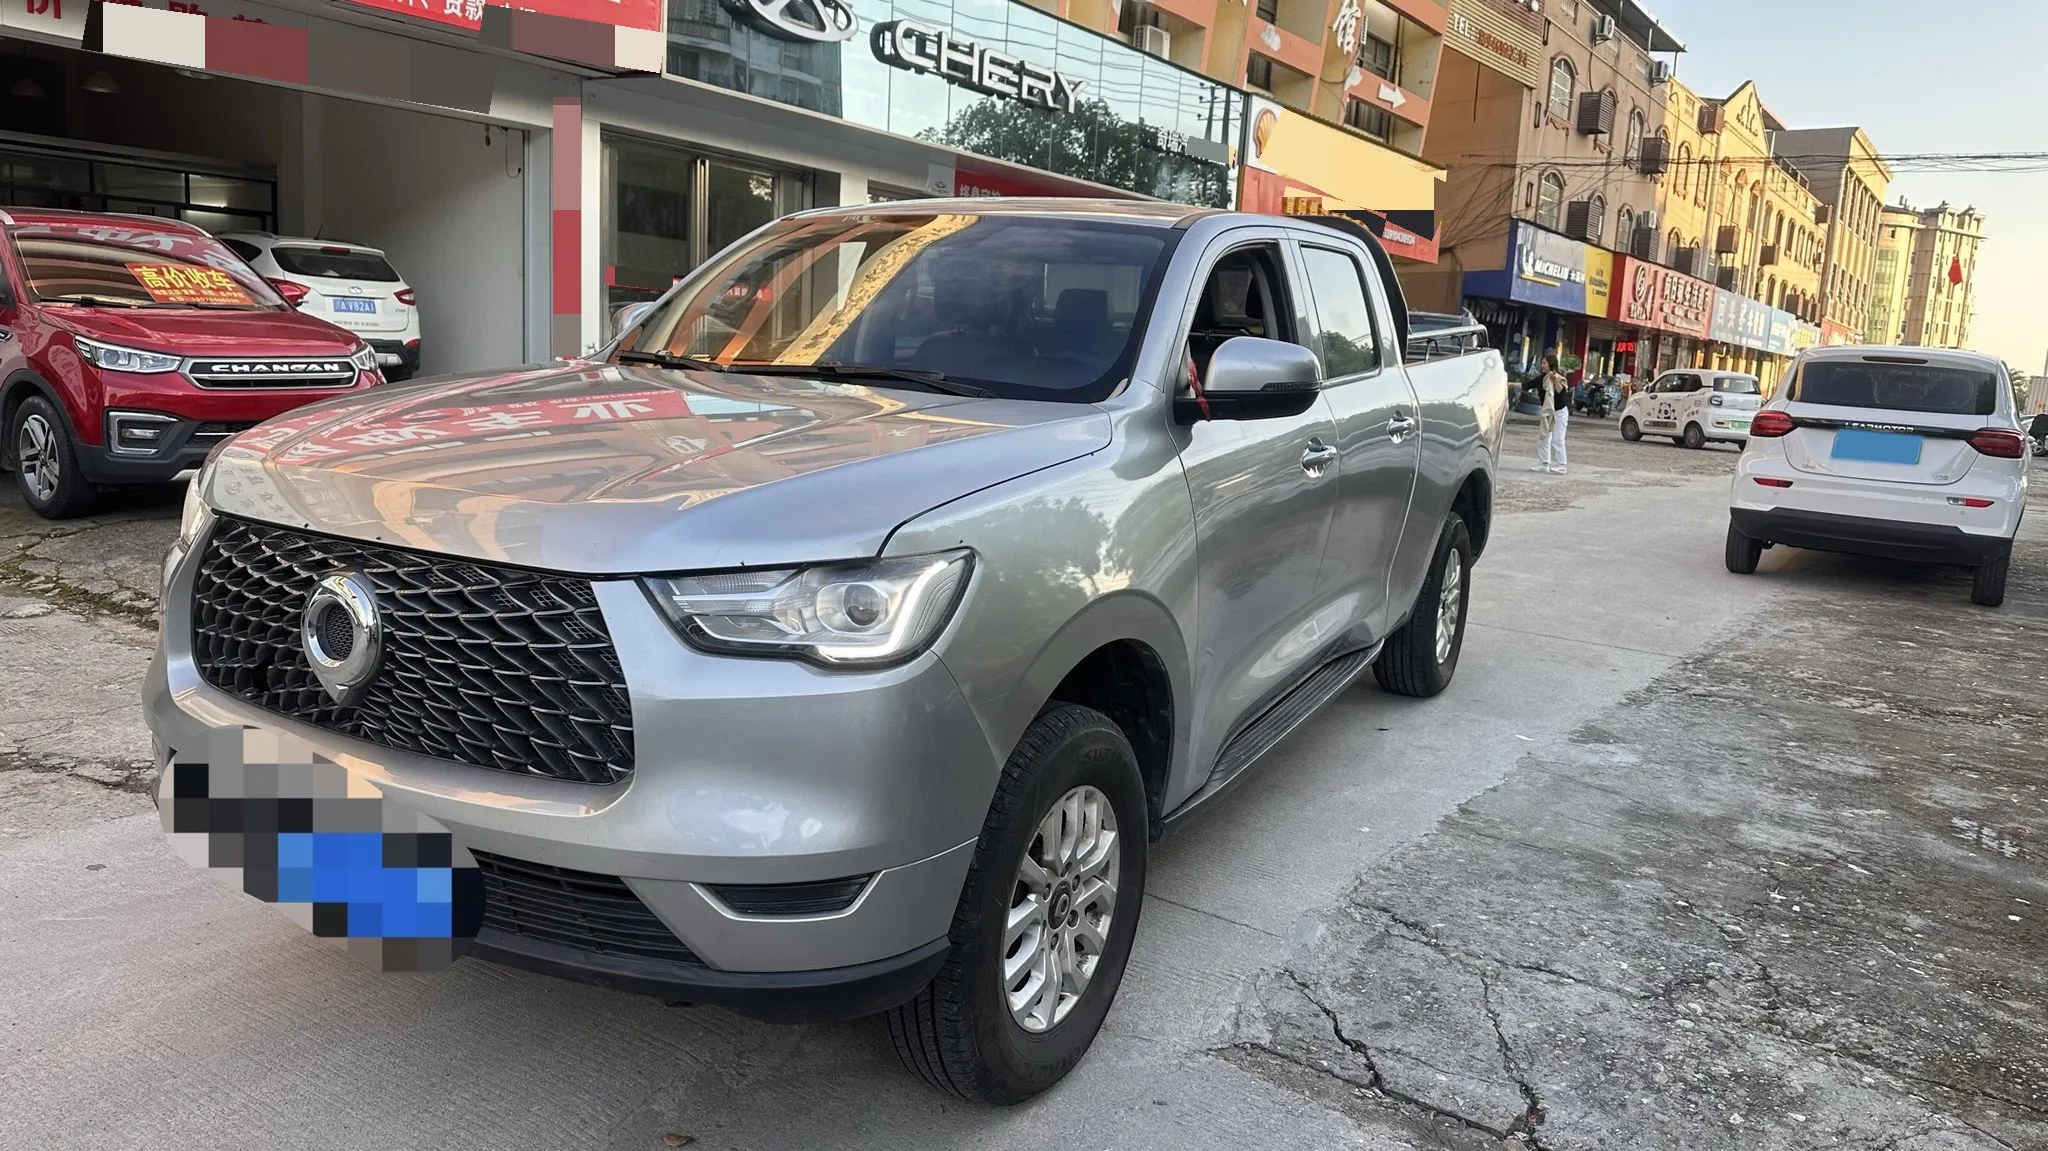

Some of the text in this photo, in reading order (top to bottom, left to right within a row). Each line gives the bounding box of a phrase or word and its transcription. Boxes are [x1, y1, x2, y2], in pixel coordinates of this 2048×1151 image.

[893, 19, 1088, 114] CHERY
[134, 266, 236, 291] 高价收车
[1534, 259, 1569, 280] MICHELIN
[211, 364, 340, 373] CHANGAN
